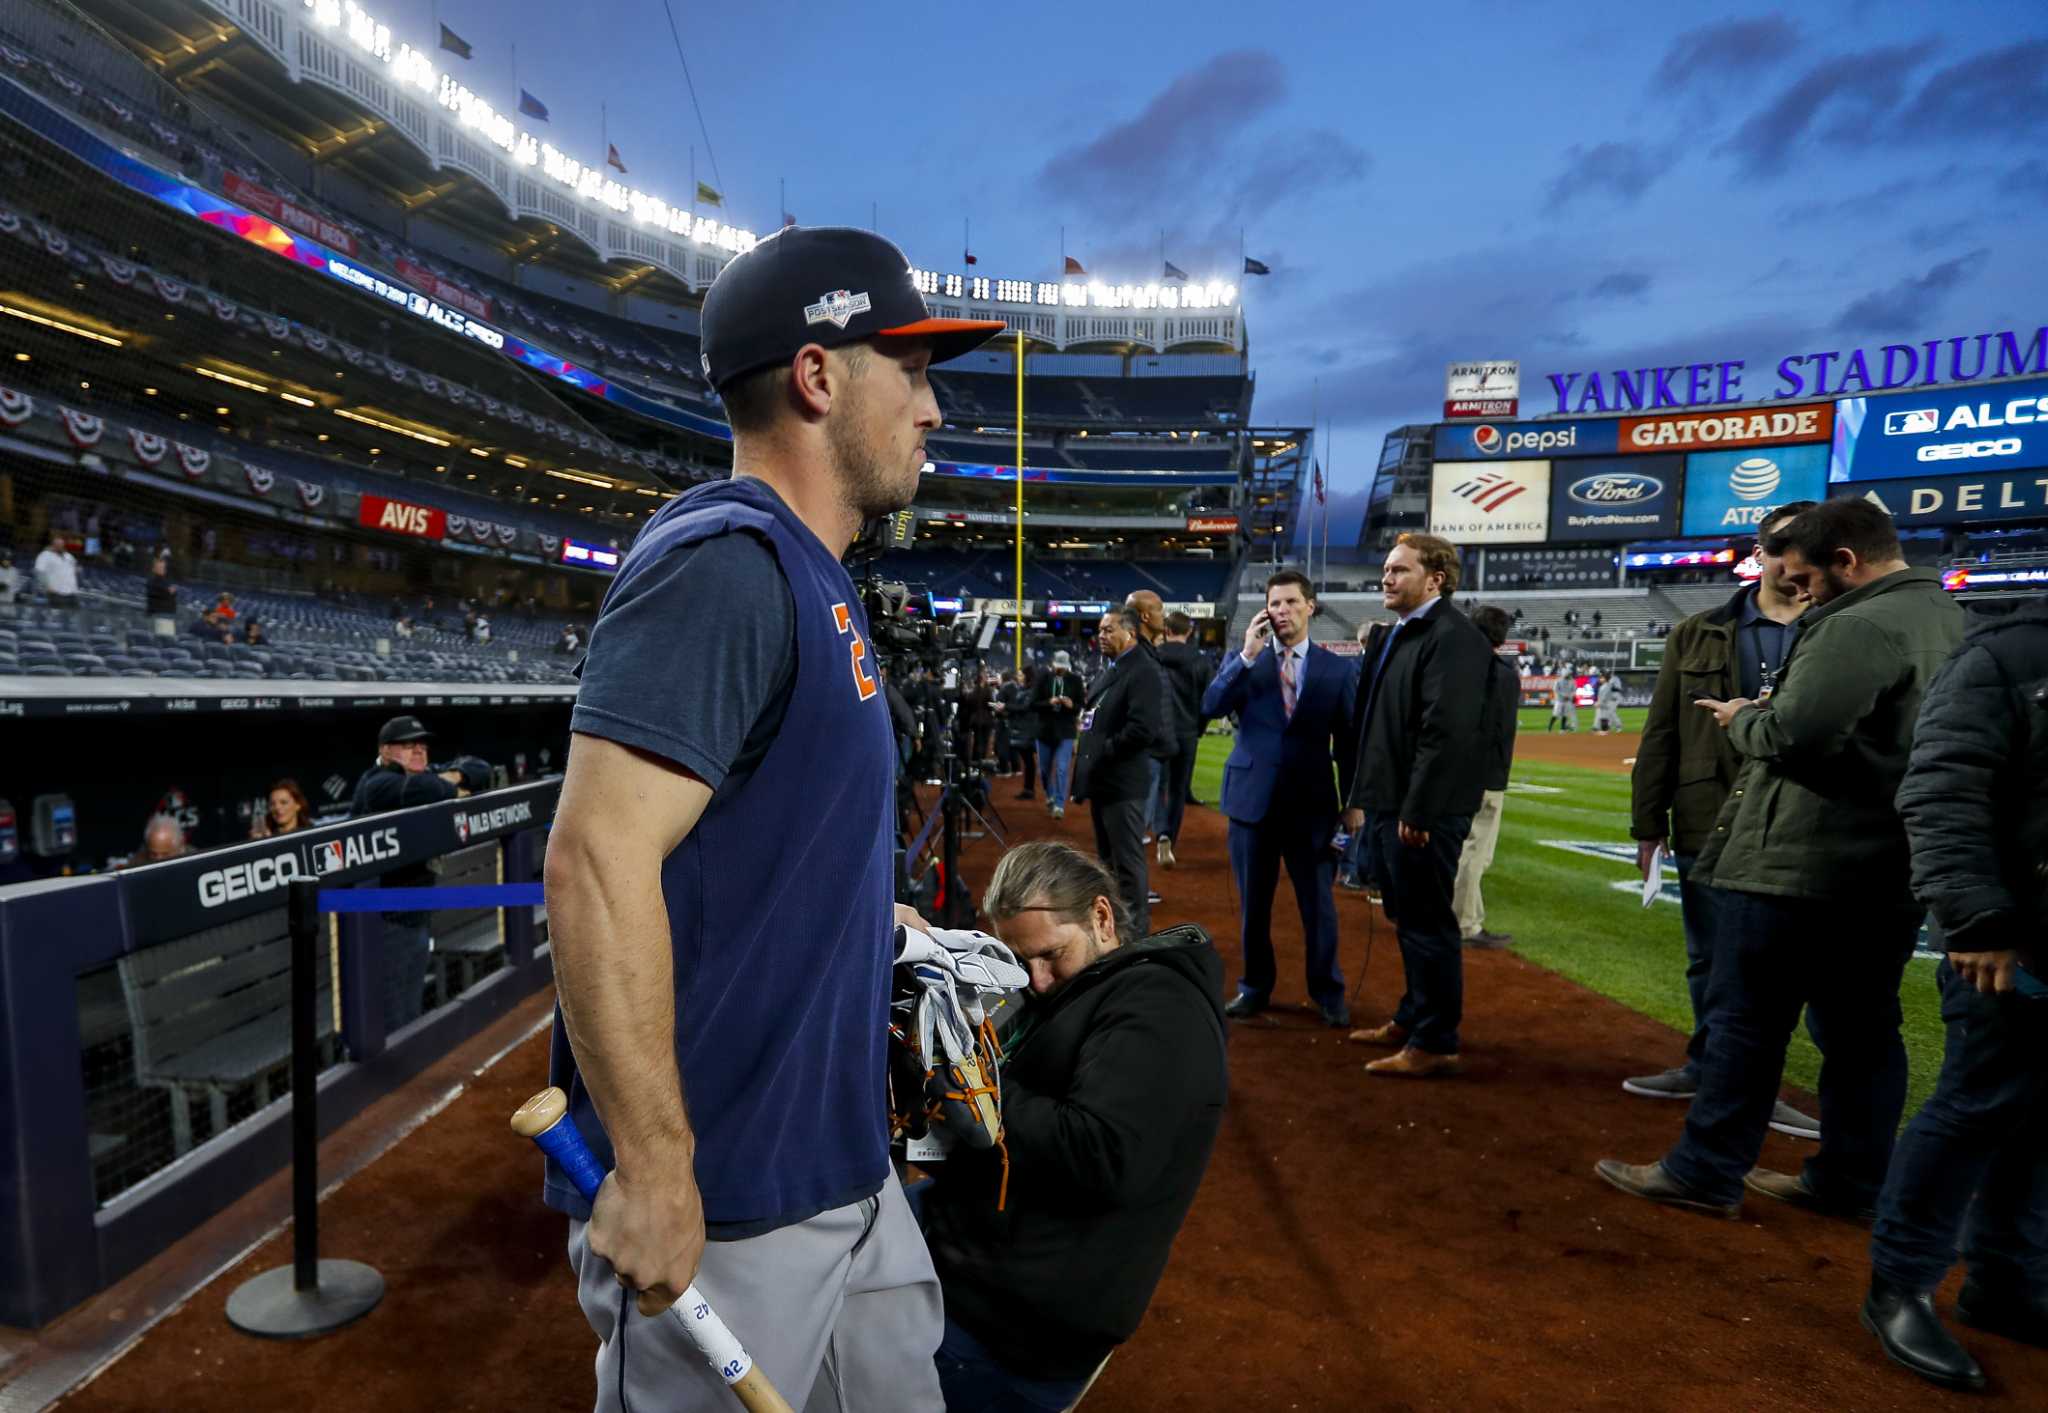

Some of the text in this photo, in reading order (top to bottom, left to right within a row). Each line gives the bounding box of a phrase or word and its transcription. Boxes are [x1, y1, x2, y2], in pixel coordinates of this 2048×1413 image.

[807, 294, 868, 317] POSTSEASON
[1451, 366, 1517, 377] ARMITRON
[1546, 326, 2048, 415] YANKEE STADIUM
[1452, 400, 1513, 412] ARMITRON
[1506, 426, 1577, 453] pepsi
[1631, 410, 1821, 447] GATORADE
[1916, 438, 2022, 462] GEICO
[1586, 478, 1646, 500] Ford
[379, 502, 430, 534] AVIS
[1432, 521, 1544, 533] BANK OF AMERICA
[1567, 514, 1660, 527] BuyFordNow.com
[468, 812, 490, 837] MLB
[488, 800, 532, 831] NETWORK
[198, 826, 400, 909] GEICO ALCS
[694, 1302, 711, 1321] 42
[723, 1359, 744, 1379] 42
